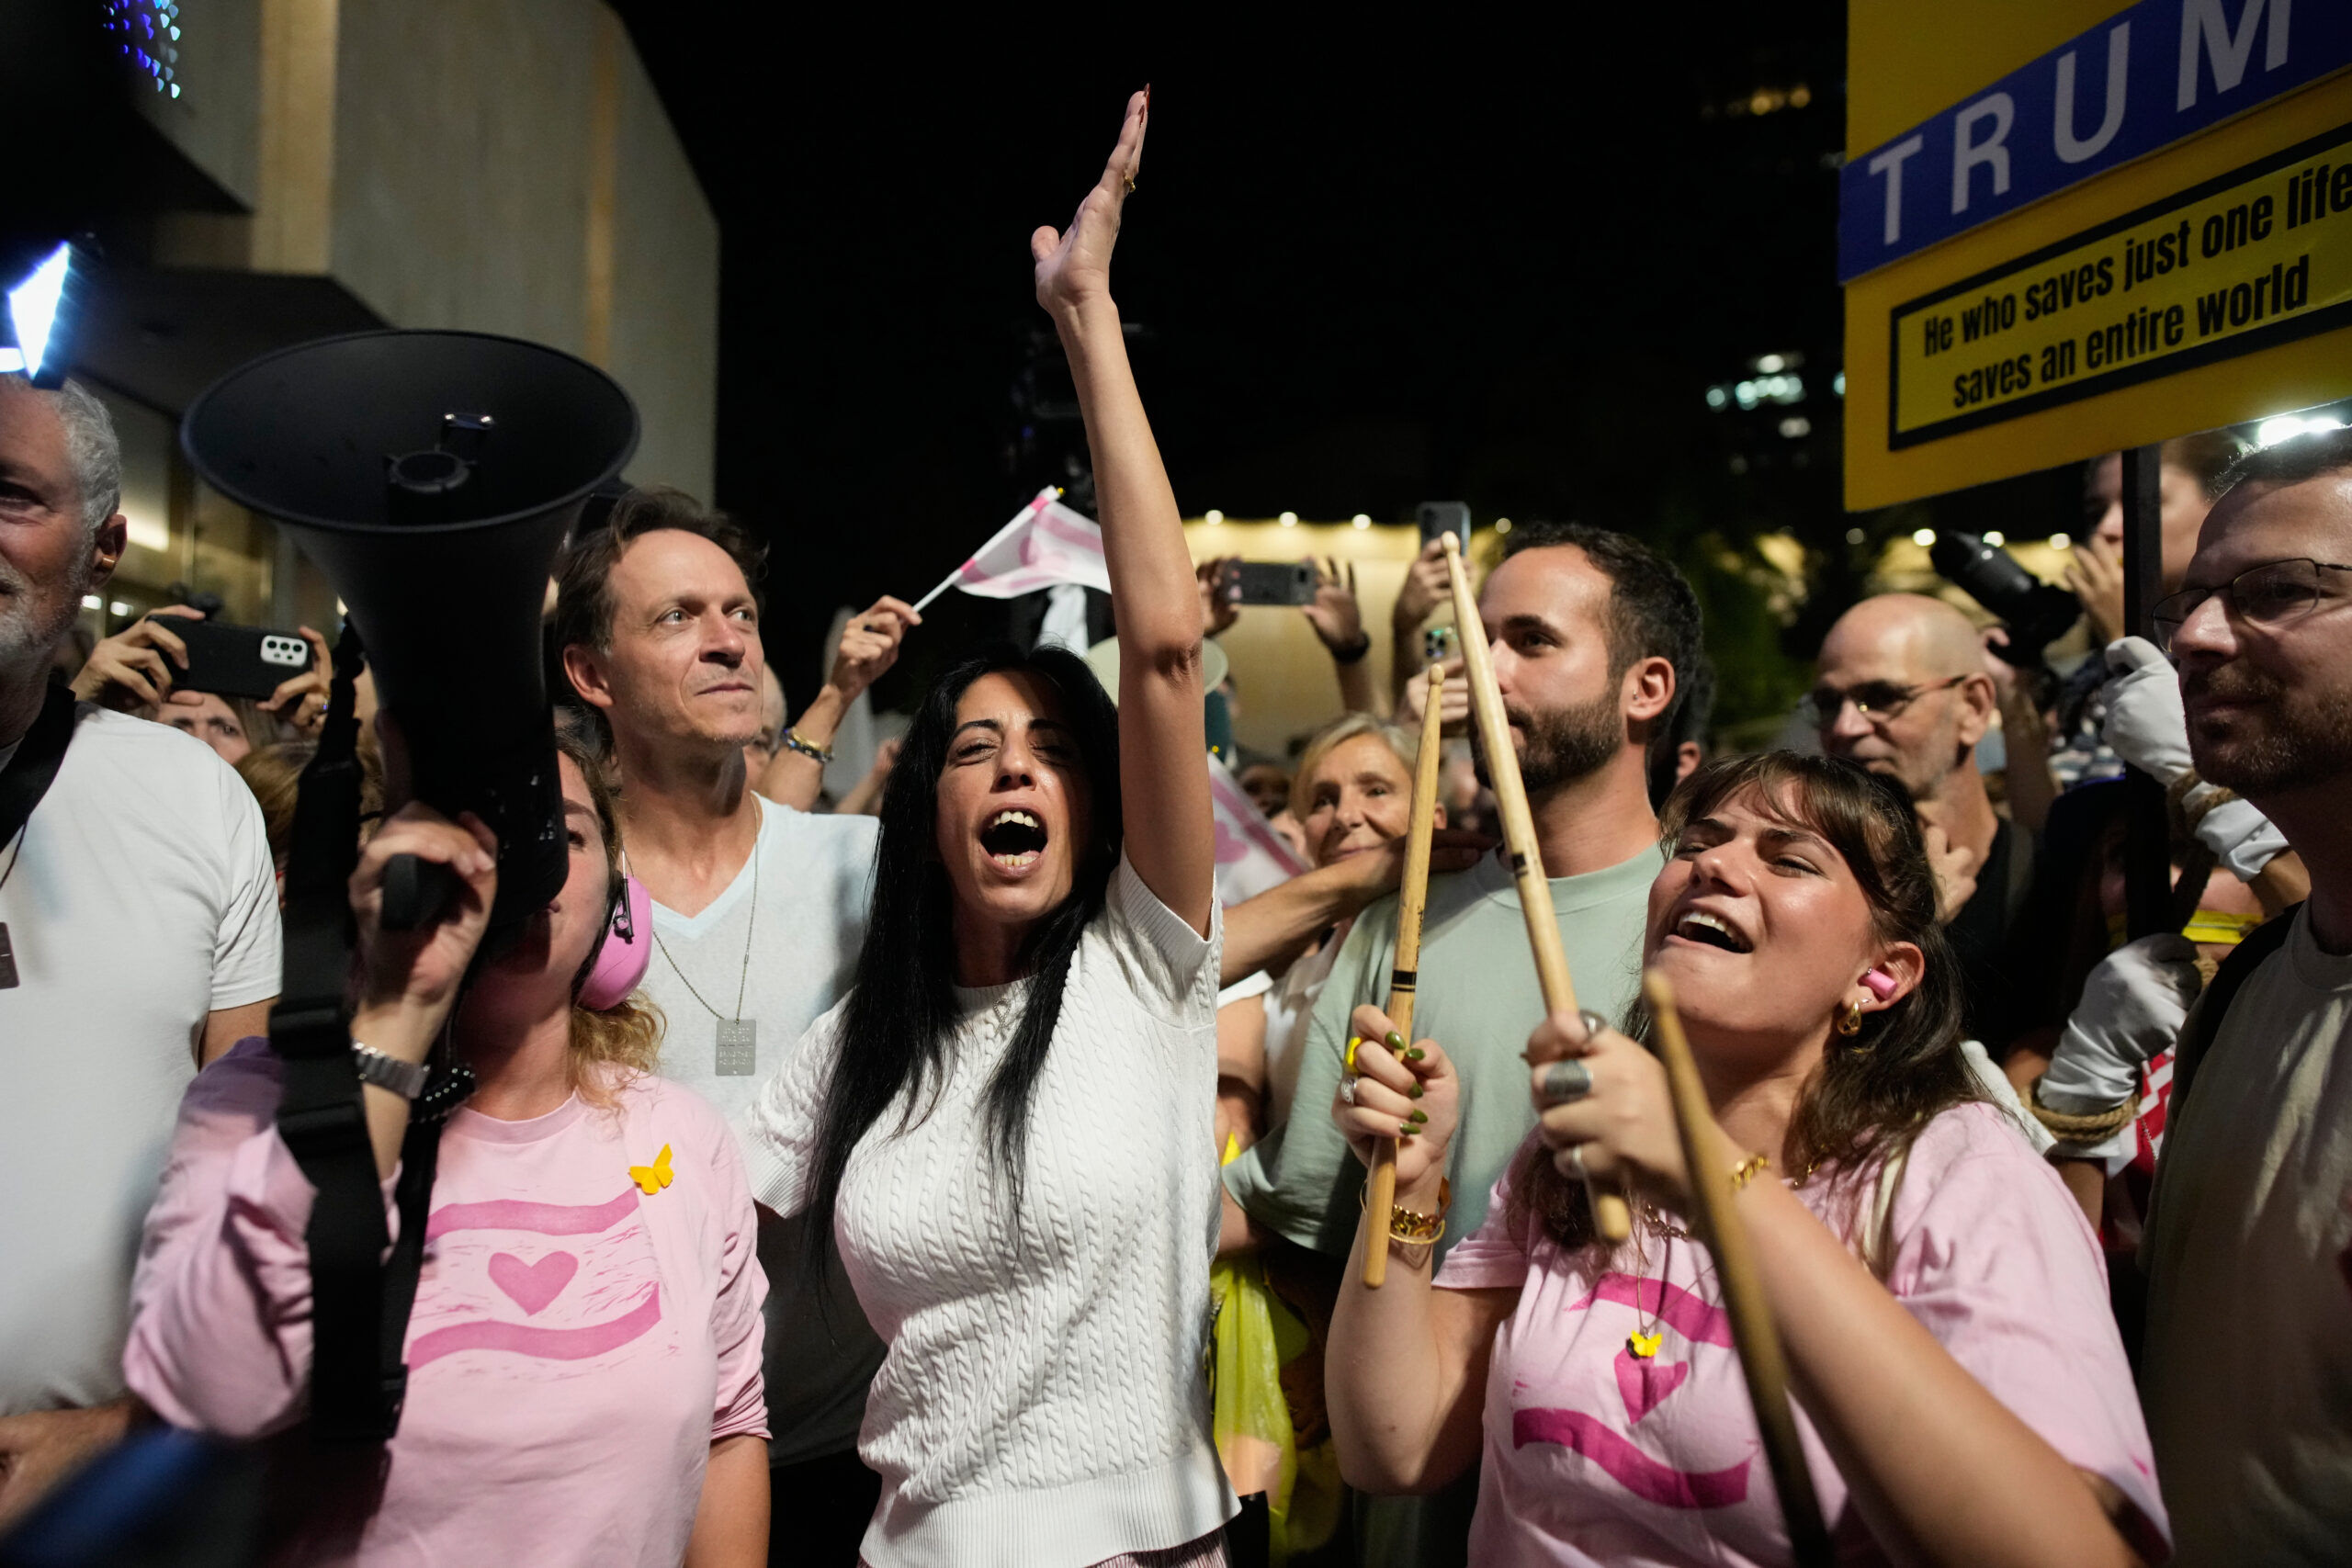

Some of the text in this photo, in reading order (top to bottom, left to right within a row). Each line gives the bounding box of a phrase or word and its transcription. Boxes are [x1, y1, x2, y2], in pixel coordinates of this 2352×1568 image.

[1868, 0, 2291, 245] TRUM
[1924, 163, 2352, 356] He who saves just one life
[1953, 254, 2309, 408] saves an entire world
